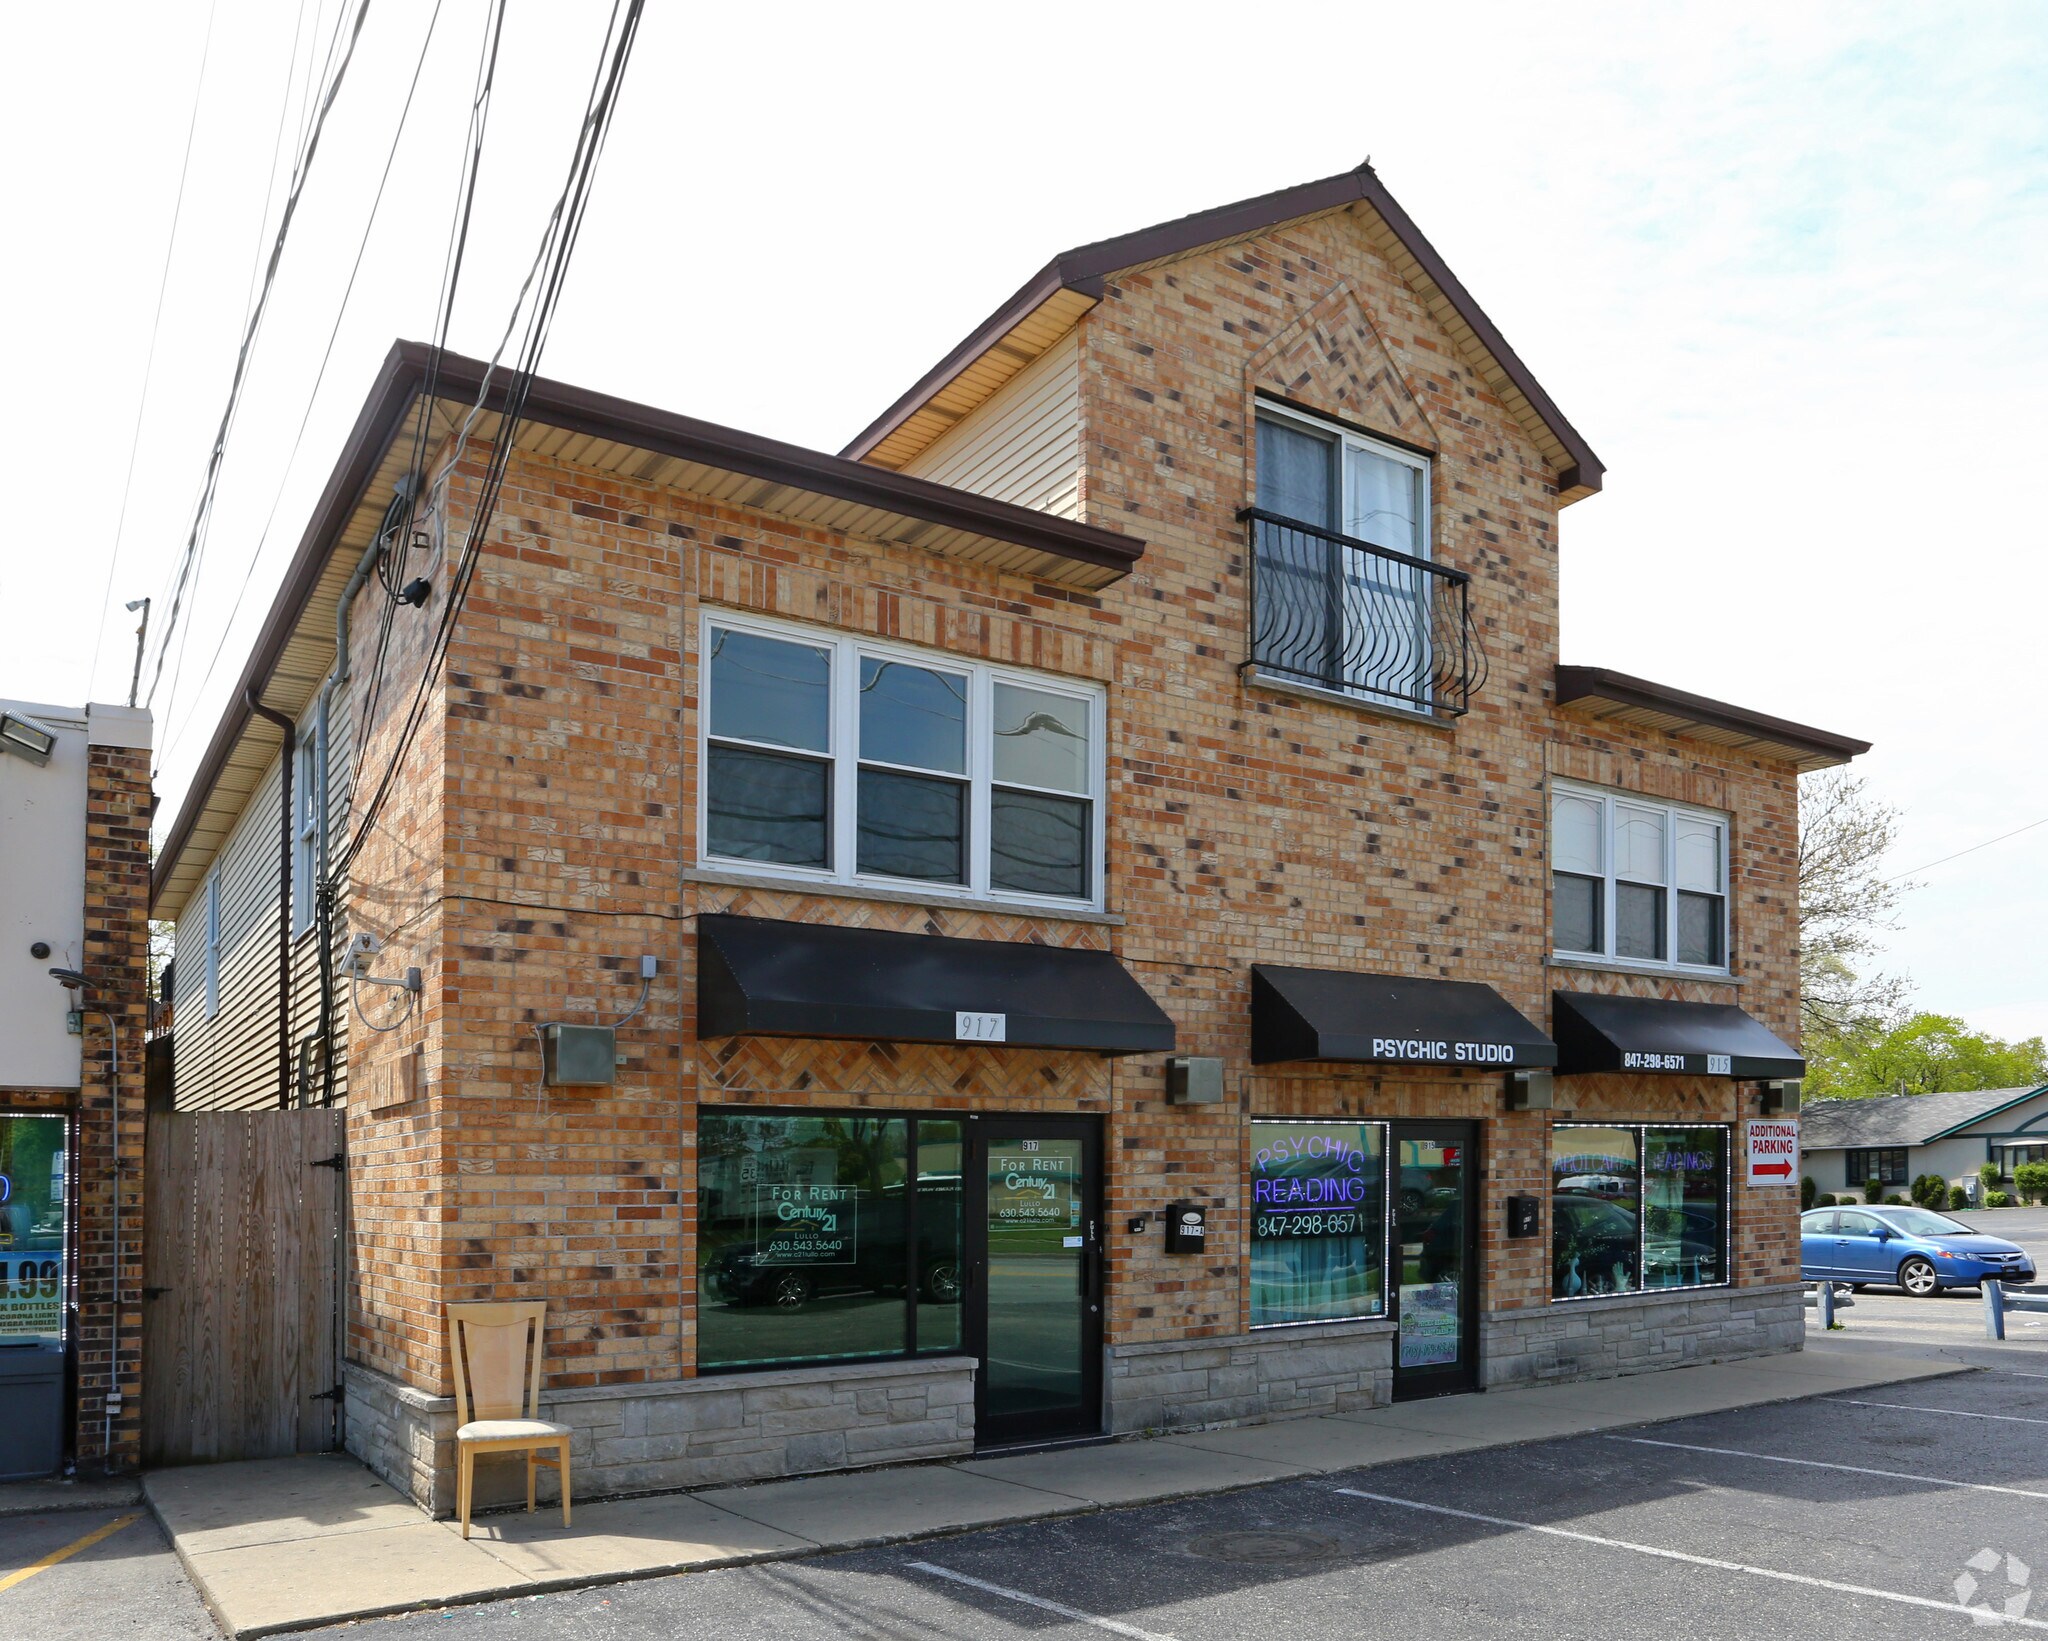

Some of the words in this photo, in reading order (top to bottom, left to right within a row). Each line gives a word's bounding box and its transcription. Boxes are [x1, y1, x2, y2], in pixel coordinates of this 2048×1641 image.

[962, 1015, 999, 1037] 917
[1372, 1038, 1447, 1060] PSYCHIC
[1455, 1042, 1514, 1062] STUDIO
[1624, 1052, 1685, 1070] 847-298-6571
[1710, 1057, 1728, 1073] 915
[1749, 1125, 1795, 1137] ADDITIONAL
[1023, 1141, 1038, 1151] 917
[1256, 1135, 1364, 1172] PSYCHIC
[1752, 1139, 1793, 1154] PARKING
[1001, 1159, 1025, 1171] FOR
[1033, 1158, 1064, 1171] RENT
[1005, 1172, 1048, 1190] Century
[1043, 1183, 1055, 1199] 21
[1256, 1177, 1365, 1203] READING
[772, 1187, 801, 1200] FOR
[810, 1187, 847, 1200] RENT
[777, 1202, 828, 1220] Century
[822, 1214, 836, 1232] 21
[1000, 1208, 1060, 1217] 630.543.5640
[1181, 1225, 1203, 1235] 917-A
[1257, 1213, 1363, 1237] 847-298-6571
[795, 1232, 819, 1240] LULLO
[770, 1240, 842, 1251] 630.543.5640
[11, 1301, 60, 1311] BOTTLES
